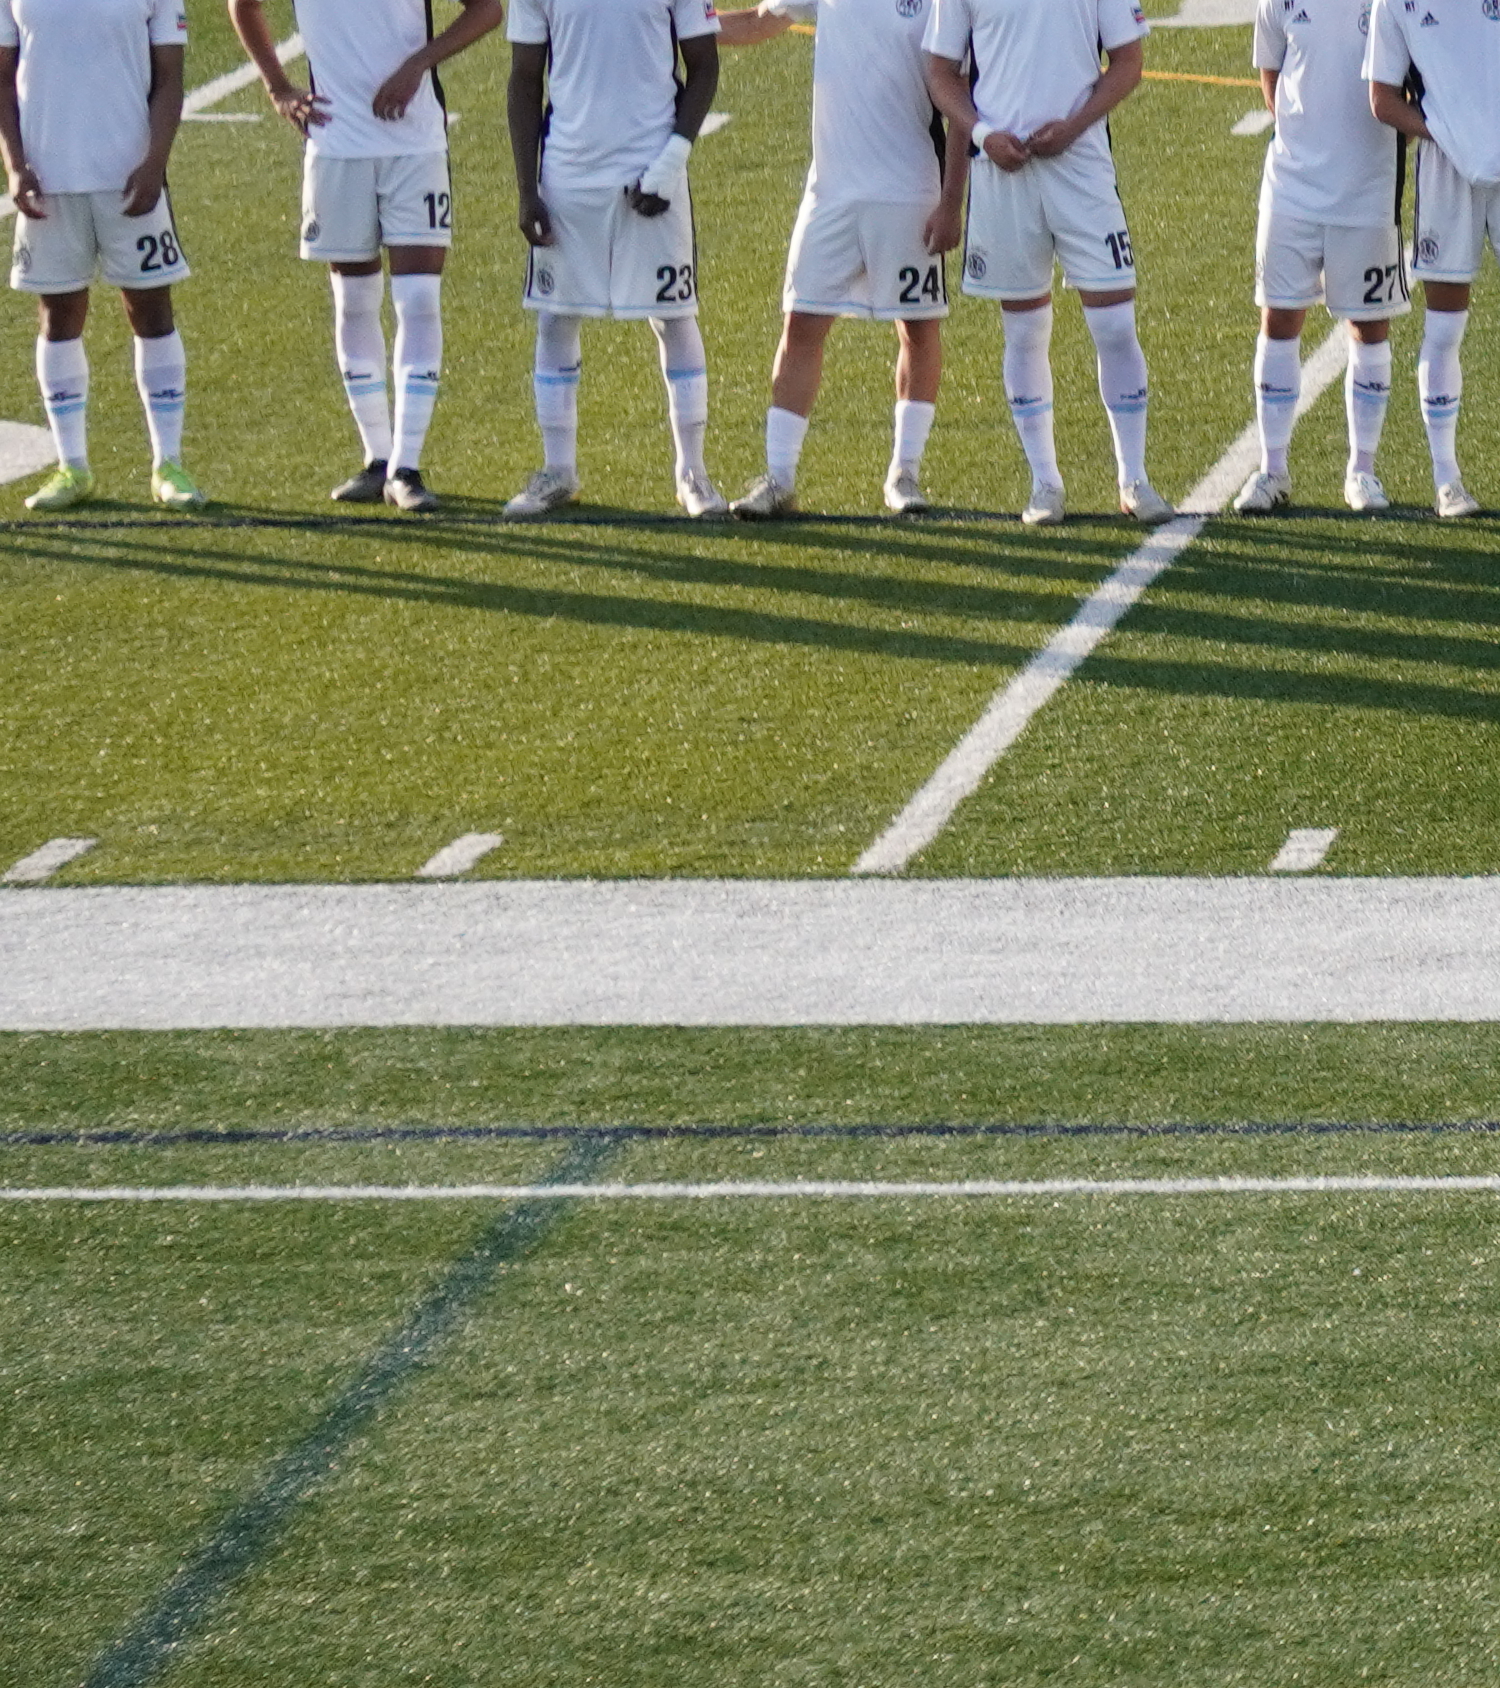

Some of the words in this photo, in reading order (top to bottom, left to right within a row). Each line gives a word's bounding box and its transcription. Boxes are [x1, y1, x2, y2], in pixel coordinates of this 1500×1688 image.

[423, 192, 450, 229] 12
[136, 230, 179, 272] 28
[1103, 230, 1134, 271] 15
[655, 263, 693, 303] 23
[898, 264, 941, 305] 24
[1362, 264, 1399, 305] 27
